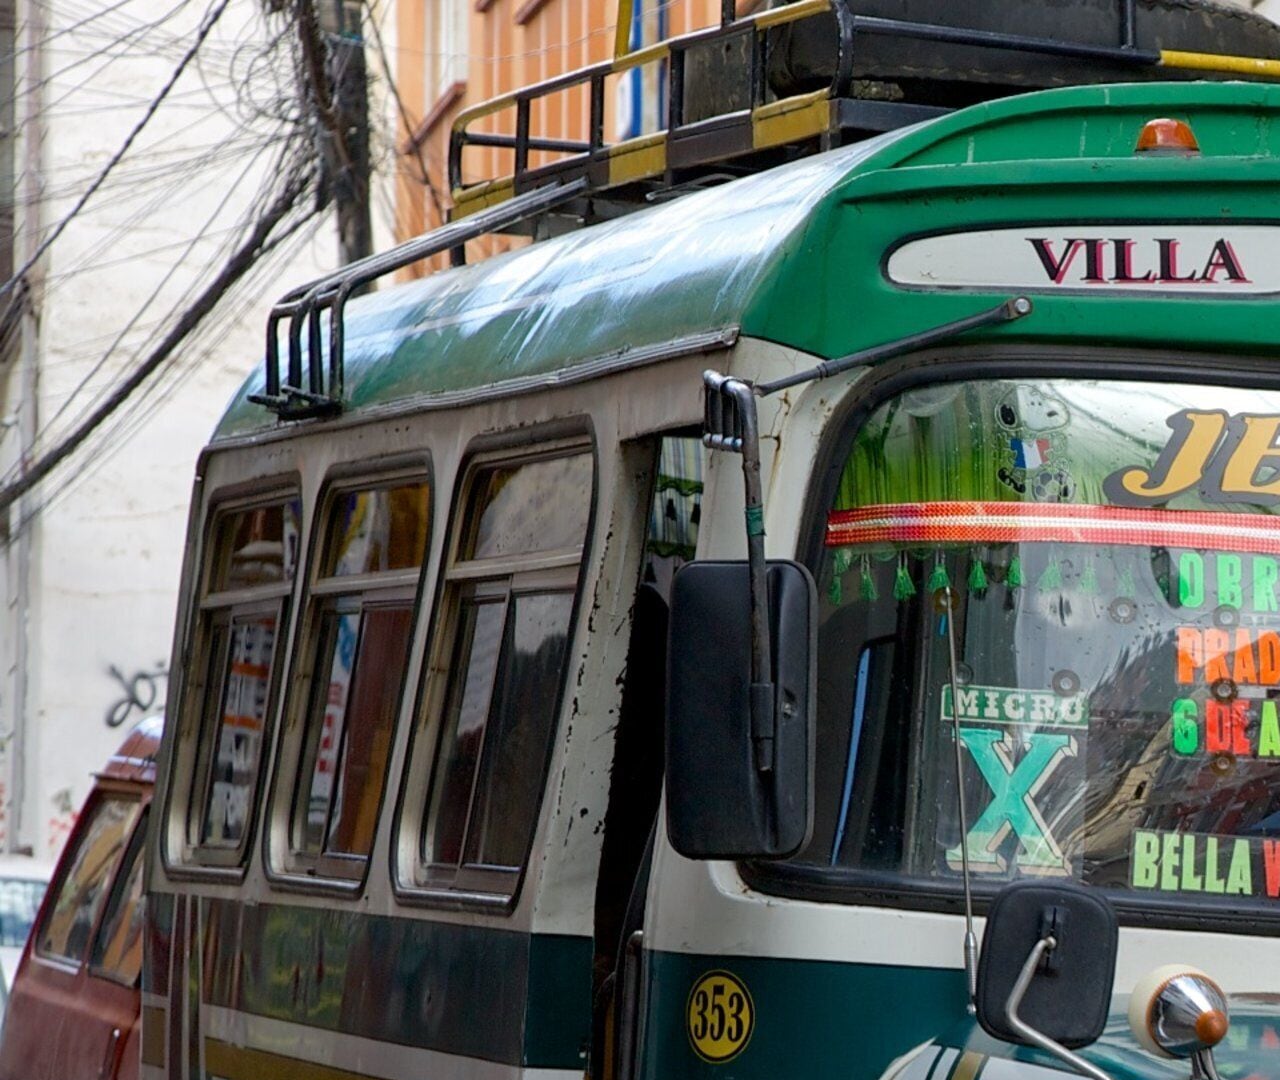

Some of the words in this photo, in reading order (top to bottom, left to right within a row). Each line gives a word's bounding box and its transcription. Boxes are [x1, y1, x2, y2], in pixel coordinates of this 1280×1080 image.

[1025, 237, 1253, 285] VILLA
[1172, 698, 1199, 757] 6
[1205, 699, 1251, 756] DE
[945, 727, 1078, 876] X
[1133, 832, 1253, 896] BELLA
[693, 983, 745, 1043] 353
